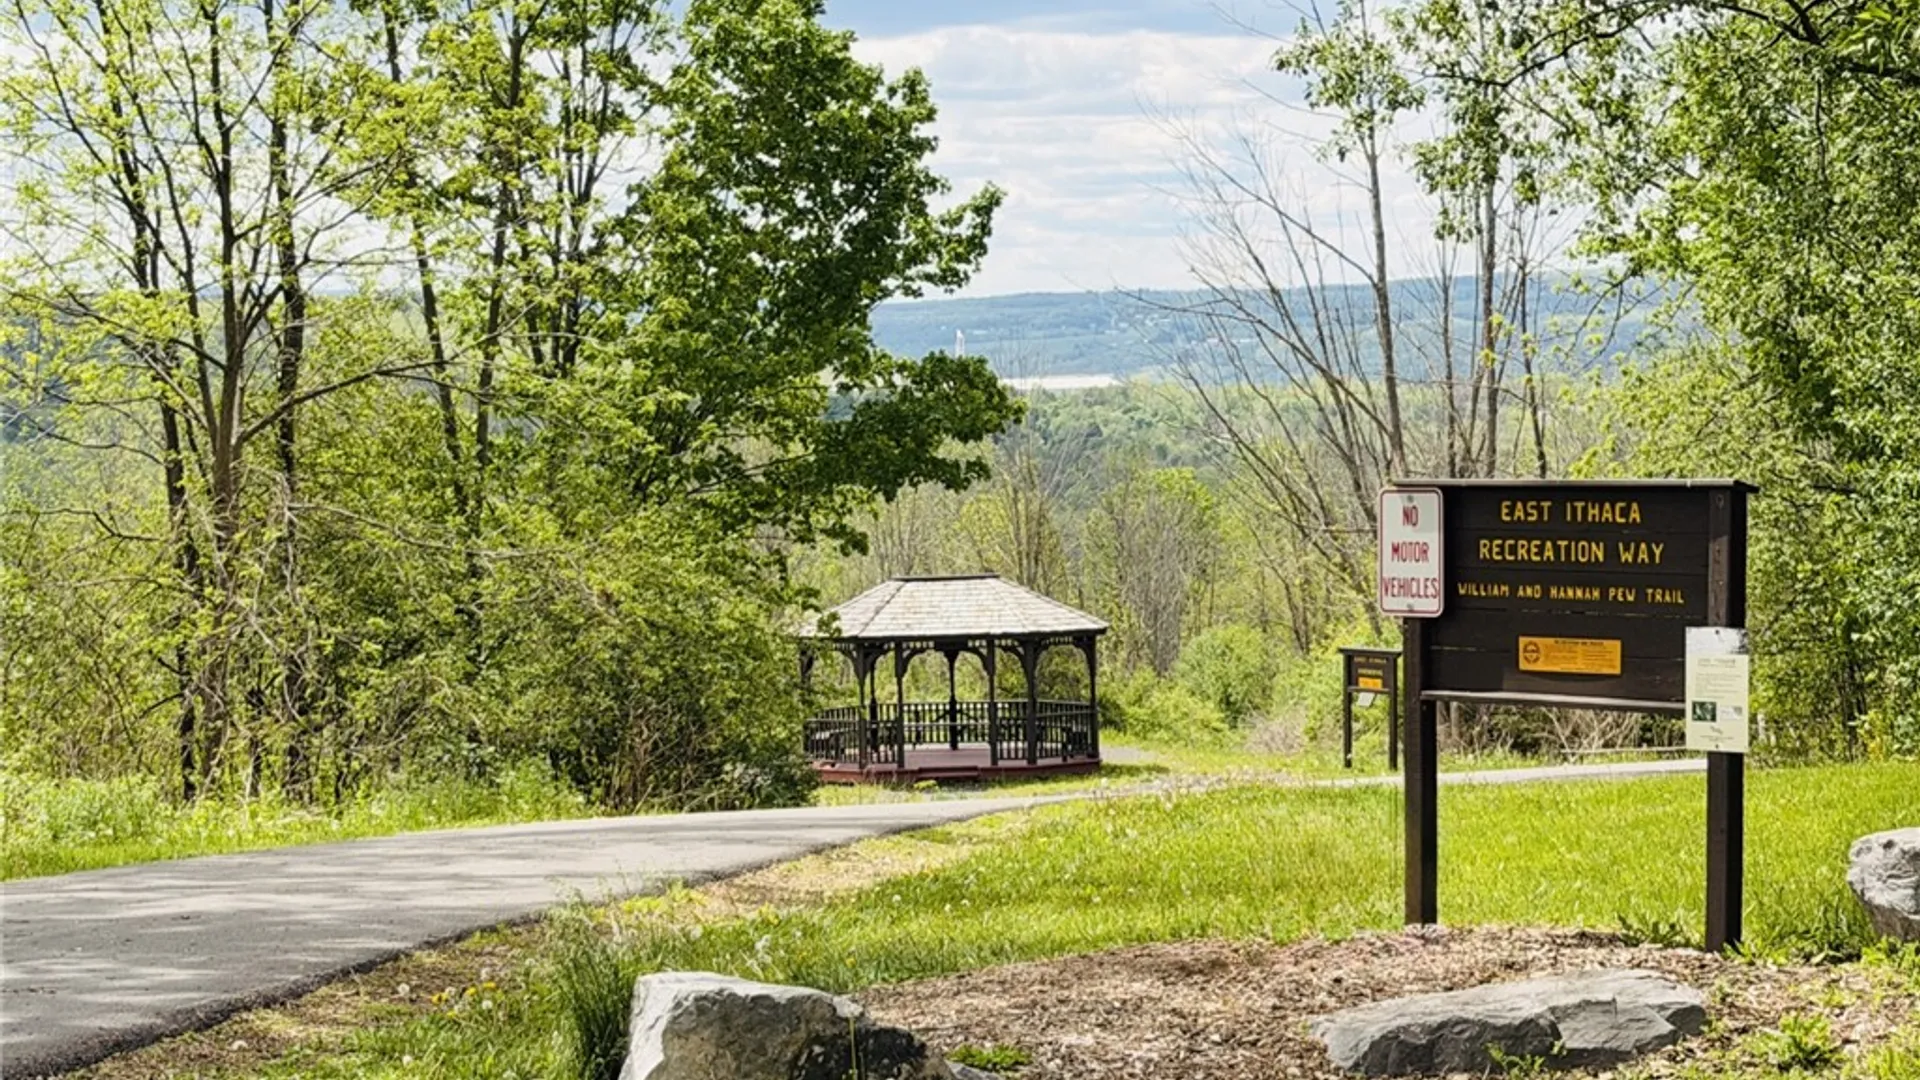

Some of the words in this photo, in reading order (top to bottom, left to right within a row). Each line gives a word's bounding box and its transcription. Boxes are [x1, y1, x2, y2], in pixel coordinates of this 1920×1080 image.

[1402, 504, 1419, 527] NO
[1501, 501, 1552, 522] EAST
[1566, 502, 1641, 524] ITHACA
[1391, 541, 1430, 563] MOTOR
[1479, 539, 1604, 563] RECREATION
[1618, 541, 1664, 565] WAY
[1382, 576, 1440, 599] VEHICLES
[1457, 582, 1509, 598] WILLIAM
[1517, 584, 1542, 599] AND
[1550, 586, 1600, 601] HANNAH
[1608, 587, 1636, 602] PEW
[1646, 588, 1685, 604] TRAIL
